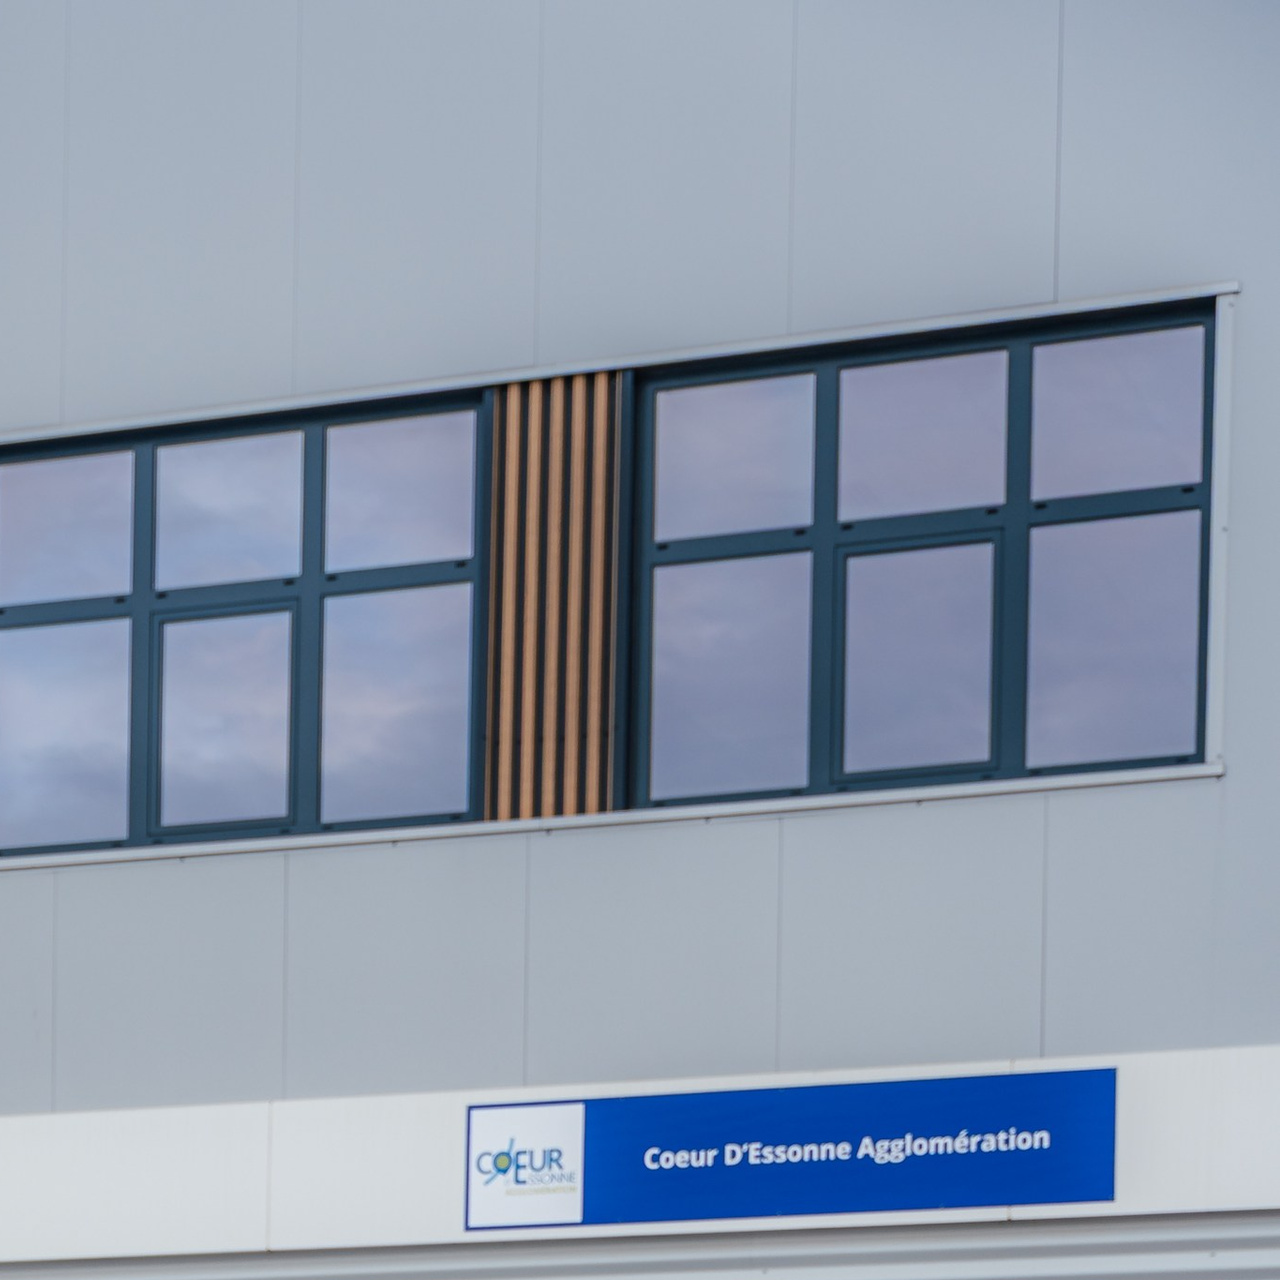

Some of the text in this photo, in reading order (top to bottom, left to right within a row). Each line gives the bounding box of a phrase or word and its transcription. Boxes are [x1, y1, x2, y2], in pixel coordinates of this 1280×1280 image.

[643, 1127, 1051, 1170] Coeur D'Essonne Agglomération
